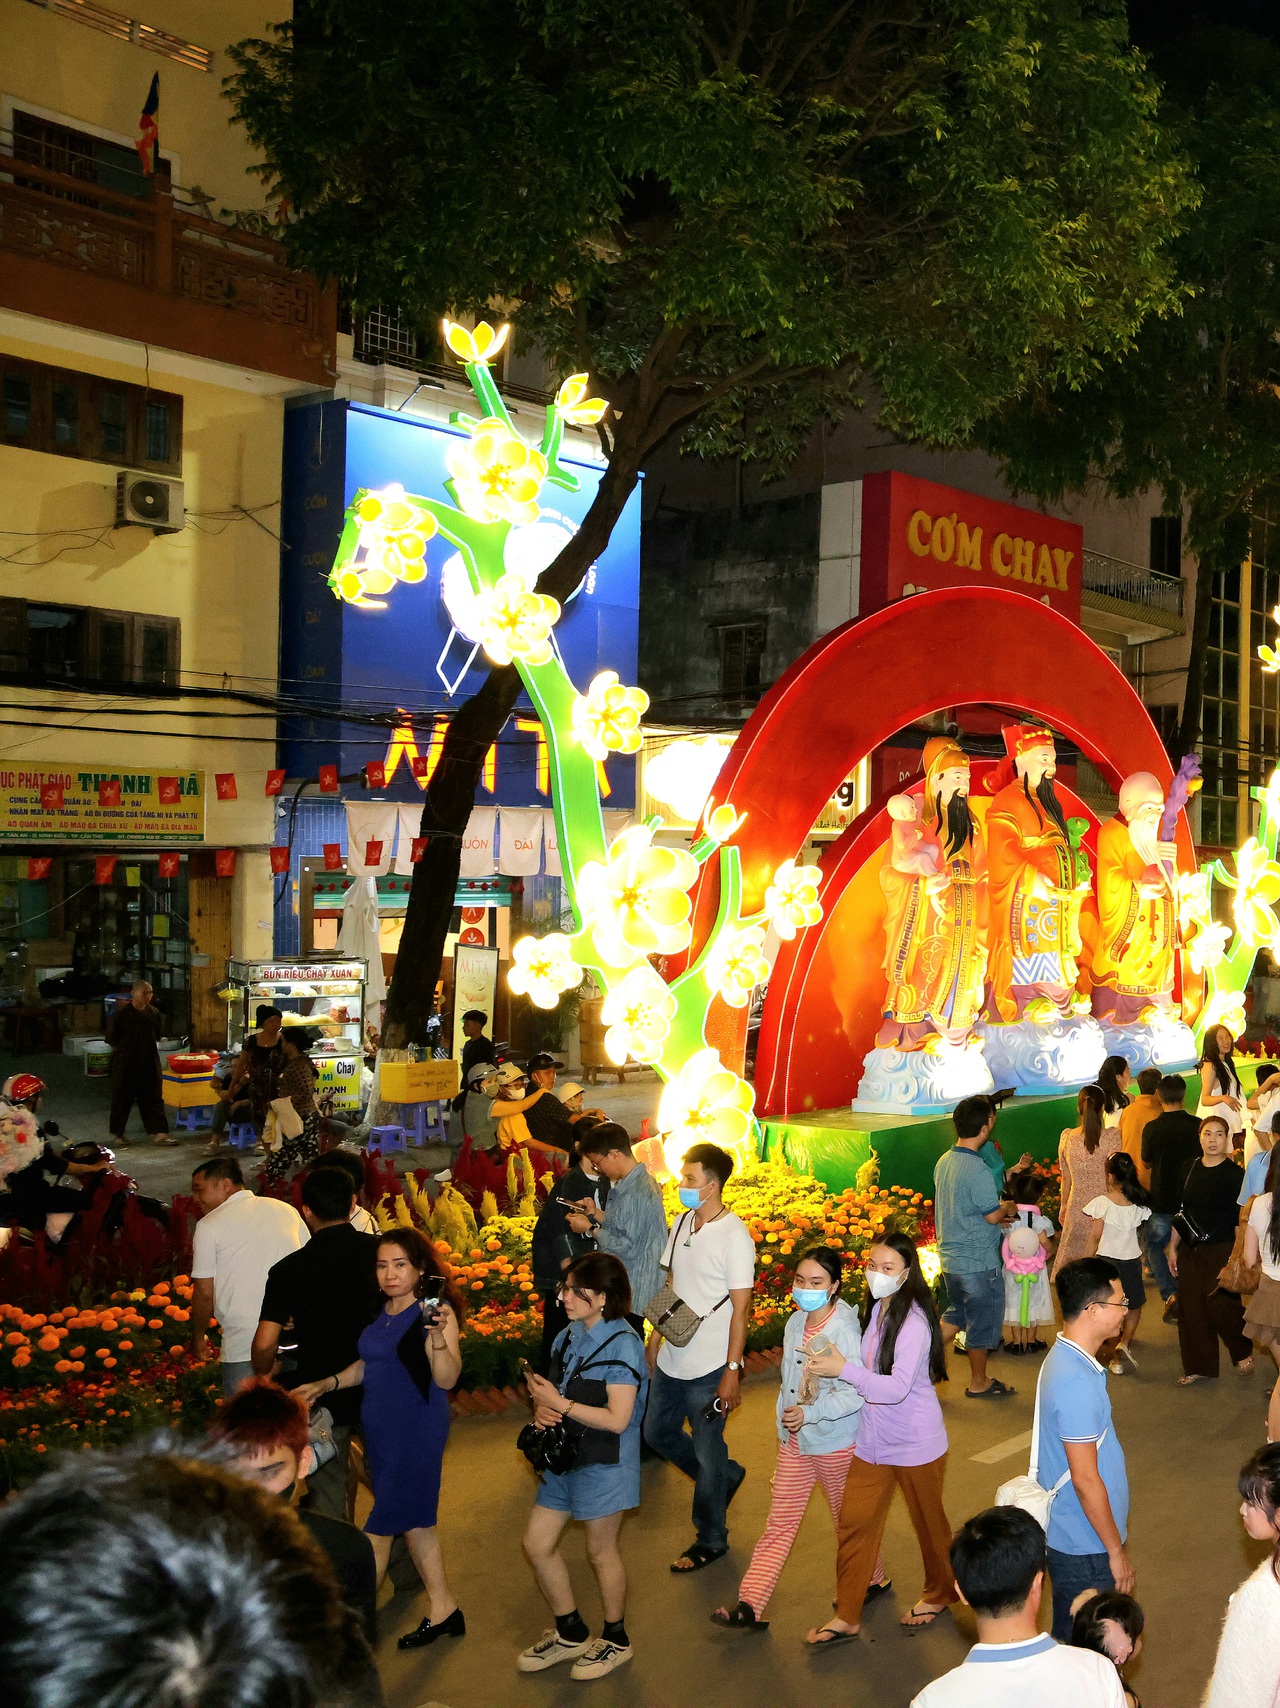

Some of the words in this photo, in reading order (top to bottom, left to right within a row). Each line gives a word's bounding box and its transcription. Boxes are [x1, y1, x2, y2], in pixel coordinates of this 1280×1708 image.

[906, 510, 983, 571] CƠM
[990, 533, 1075, 591] CHAY
[306, 969, 327, 979] CHAY
[460, 958, 489, 976] MITA
[336, 1060, 356, 1076] Chay
